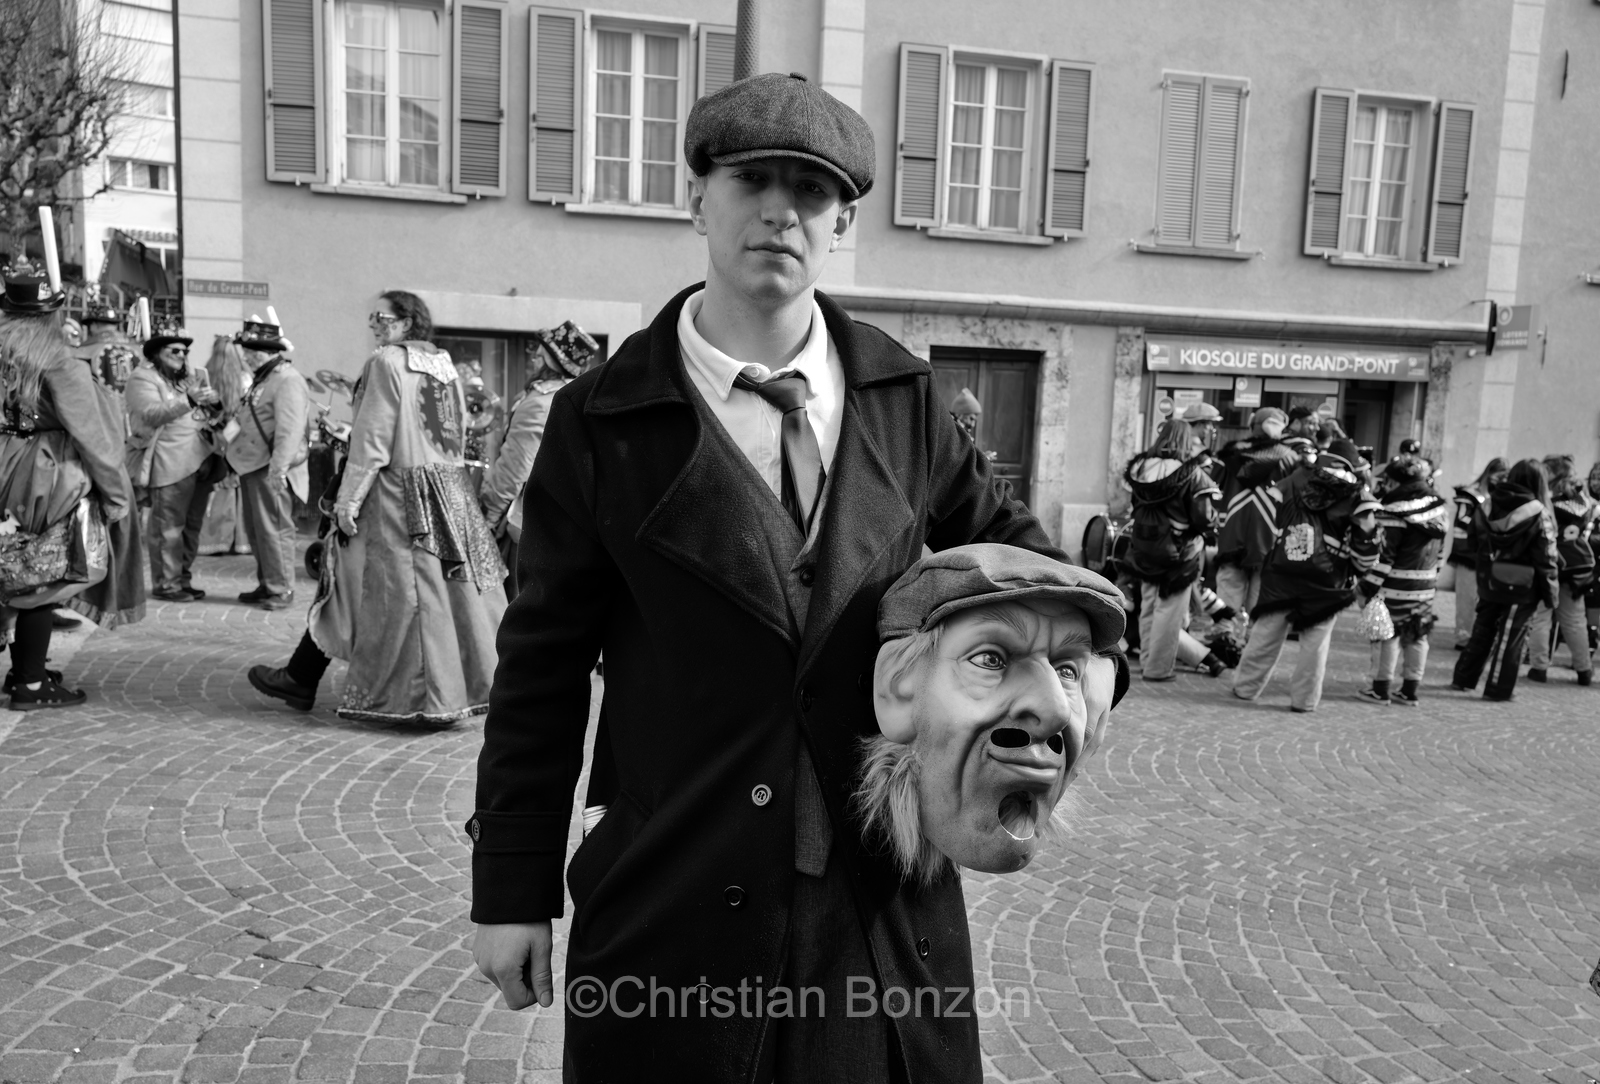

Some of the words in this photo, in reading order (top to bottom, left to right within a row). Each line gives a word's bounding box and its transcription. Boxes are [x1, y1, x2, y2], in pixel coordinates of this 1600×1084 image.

[189, 280, 204, 292] Rue
[207, 281, 218, 293] du
[220, 282, 268, 295] Grand-Pont
[1180, 348, 1258, 369] KIOSQUE
[1261, 352, 1287, 370] DU
[1289, 354, 1400, 375] GRAND-PONT
